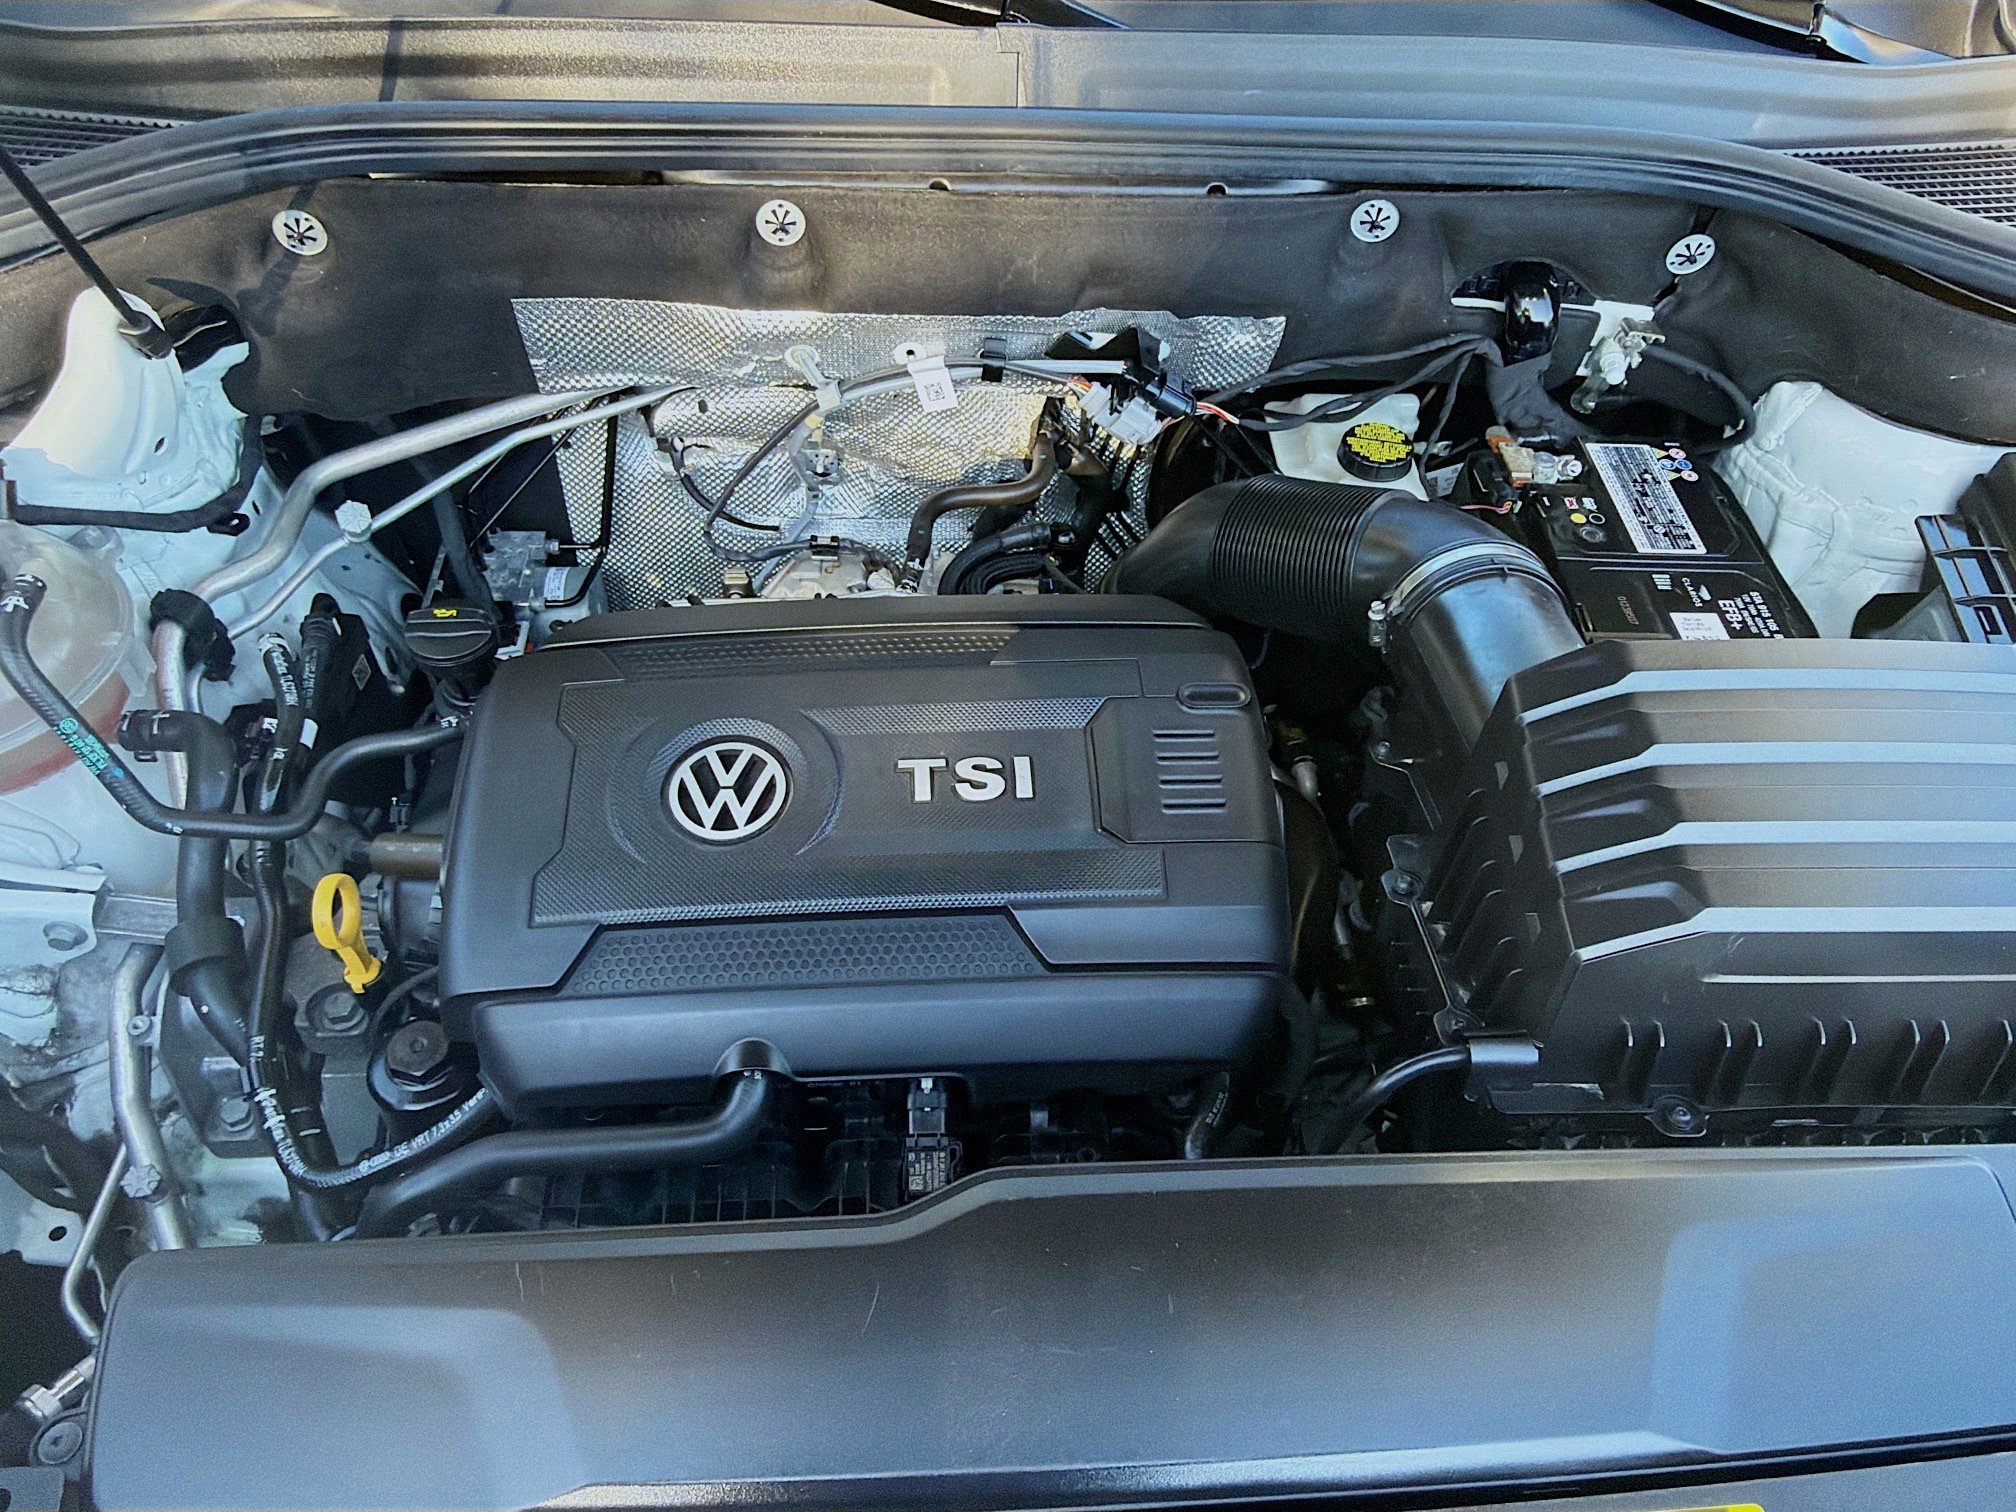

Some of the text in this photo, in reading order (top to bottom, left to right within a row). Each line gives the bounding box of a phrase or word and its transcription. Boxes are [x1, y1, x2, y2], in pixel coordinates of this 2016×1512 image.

[1682, 577, 1703, 607] CLARIOS
[1717, 600, 1743, 630] EFB+
[897, 756, 1034, 802] TSI
